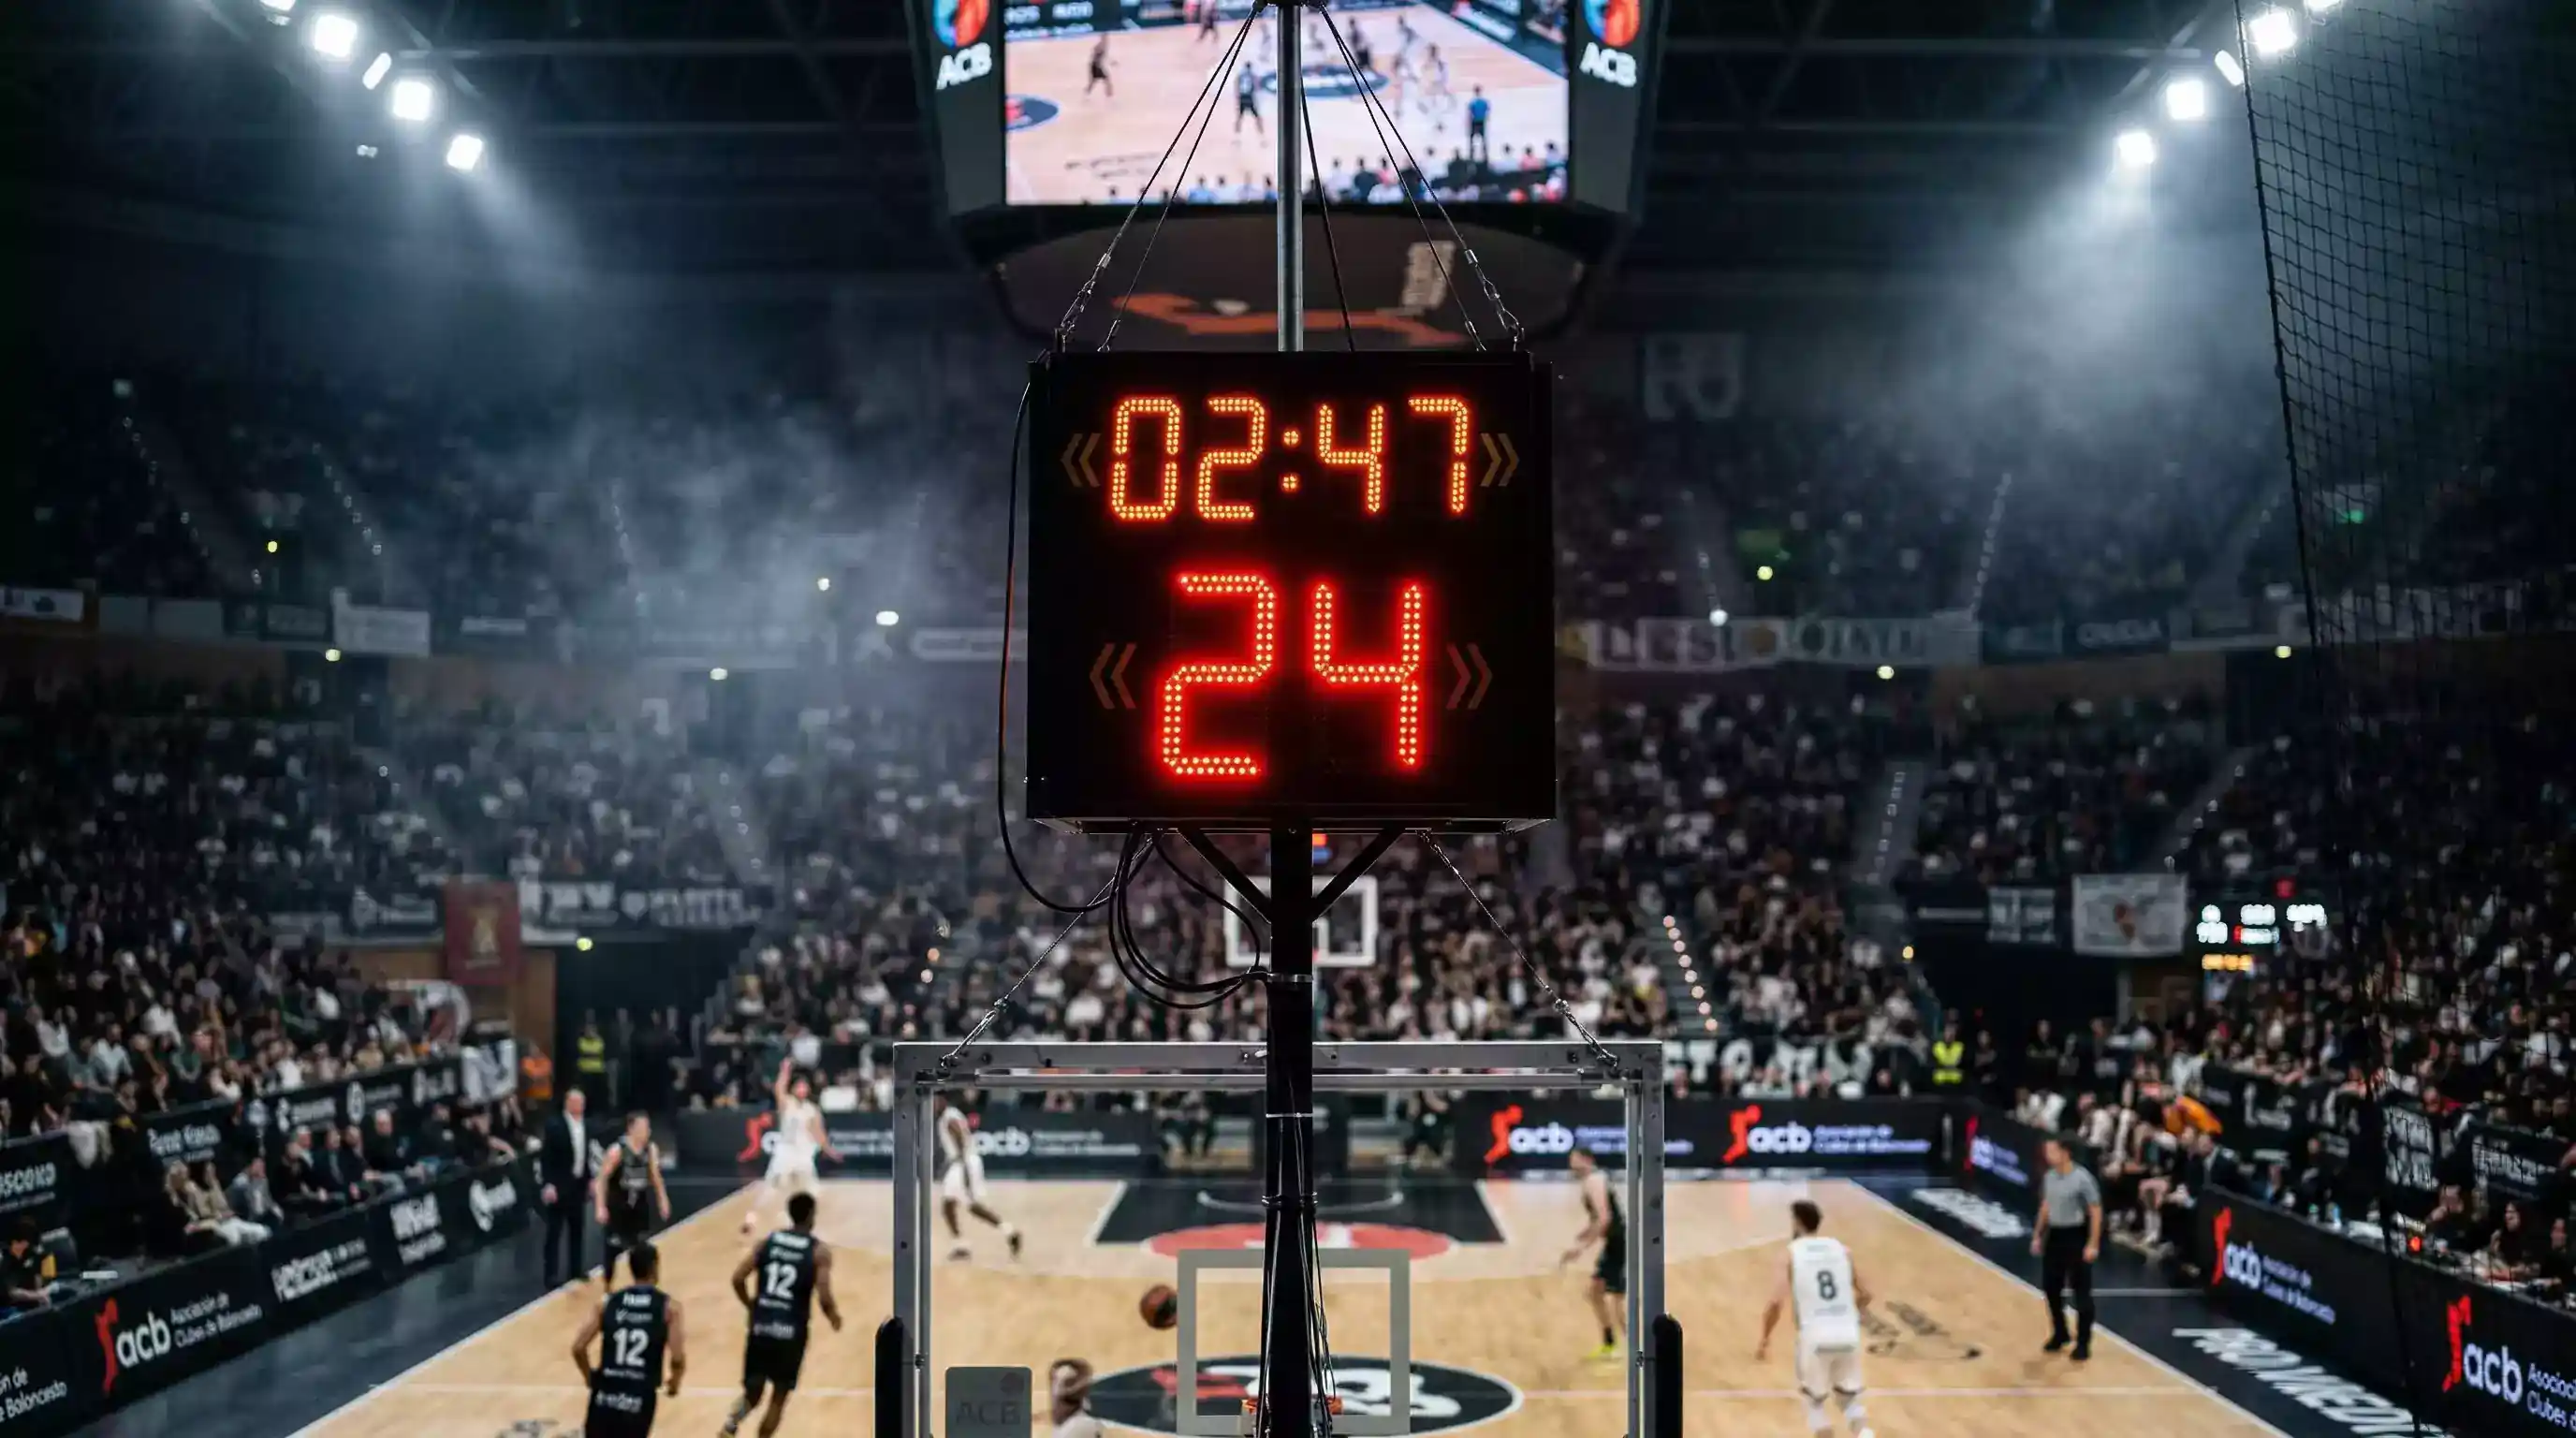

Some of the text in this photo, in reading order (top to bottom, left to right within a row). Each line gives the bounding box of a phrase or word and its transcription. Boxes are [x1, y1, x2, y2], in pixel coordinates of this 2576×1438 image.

[936, 42, 992, 89] ACB
[1579, 42, 1637, 87] ACB
[1110, 396, 1470, 521] 02:47
[1162, 573, 1423, 776] 24
[1508, 1122, 1574, 1153] acb
[1748, 1121, 1812, 1153] acb
[766, 1264, 797, 1299] 12
[2223, 1240, 2261, 1289] acb
[1817, 1269, 1837, 1301] 8
[116, 1309, 172, 1369] acb
[614, 1328, 650, 1367] 12
[12, 1366, 28, 1388] de
[2463, 1343, 2524, 1405] acb
[5, 1380, 67, 1419] Baloncesto
[956, 1401, 1021, 1426] ACB
[2527, 1389, 2568, 1429] Clubes
